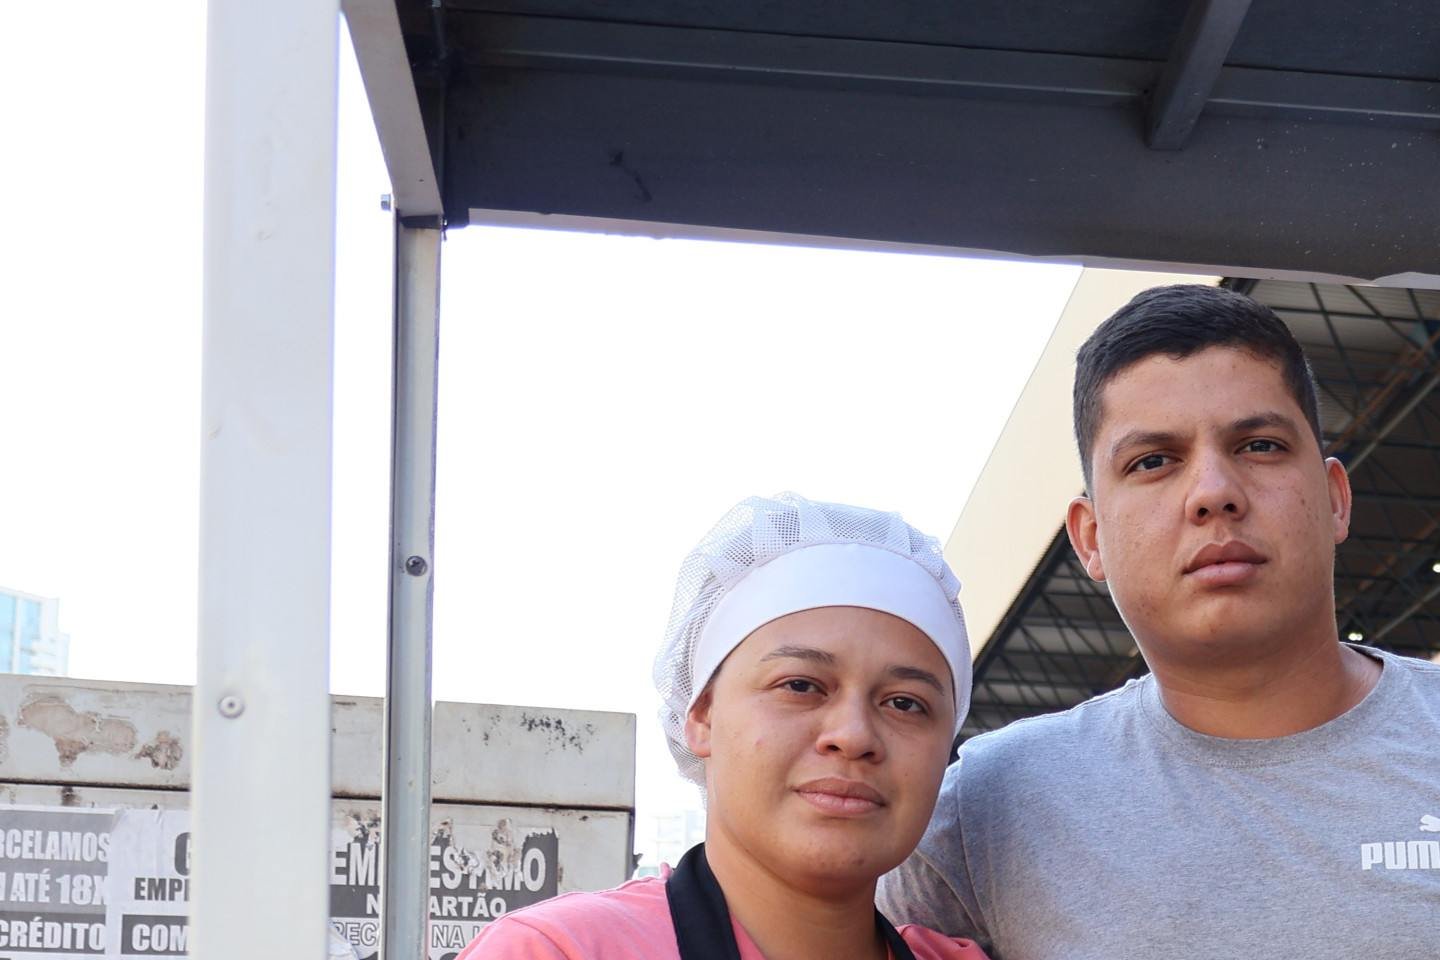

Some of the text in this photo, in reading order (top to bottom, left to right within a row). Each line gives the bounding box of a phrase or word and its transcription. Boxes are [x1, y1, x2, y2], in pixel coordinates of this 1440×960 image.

[10, 868, 51, 903] ATÉ
[430, 892, 507, 918] ARTÃO
[431, 925, 466, 949] NA
